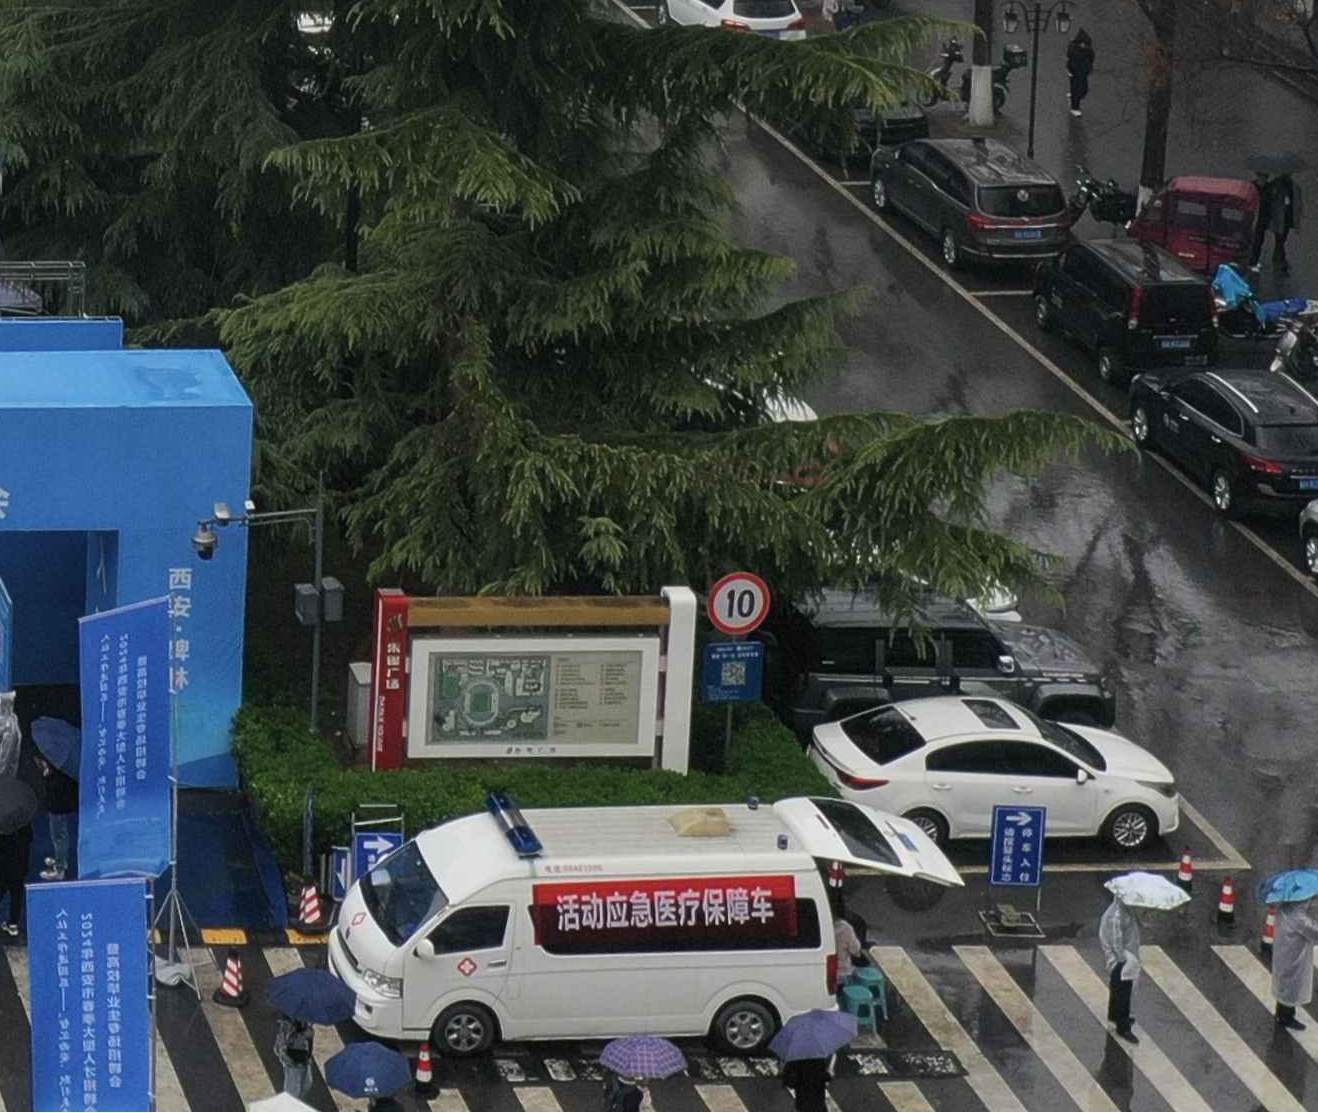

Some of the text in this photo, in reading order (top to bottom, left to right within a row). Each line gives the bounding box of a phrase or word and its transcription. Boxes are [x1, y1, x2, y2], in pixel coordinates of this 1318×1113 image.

[726, 589, 755, 618] 10
[556, 887, 775, 932] 活动应急医疗保障车
